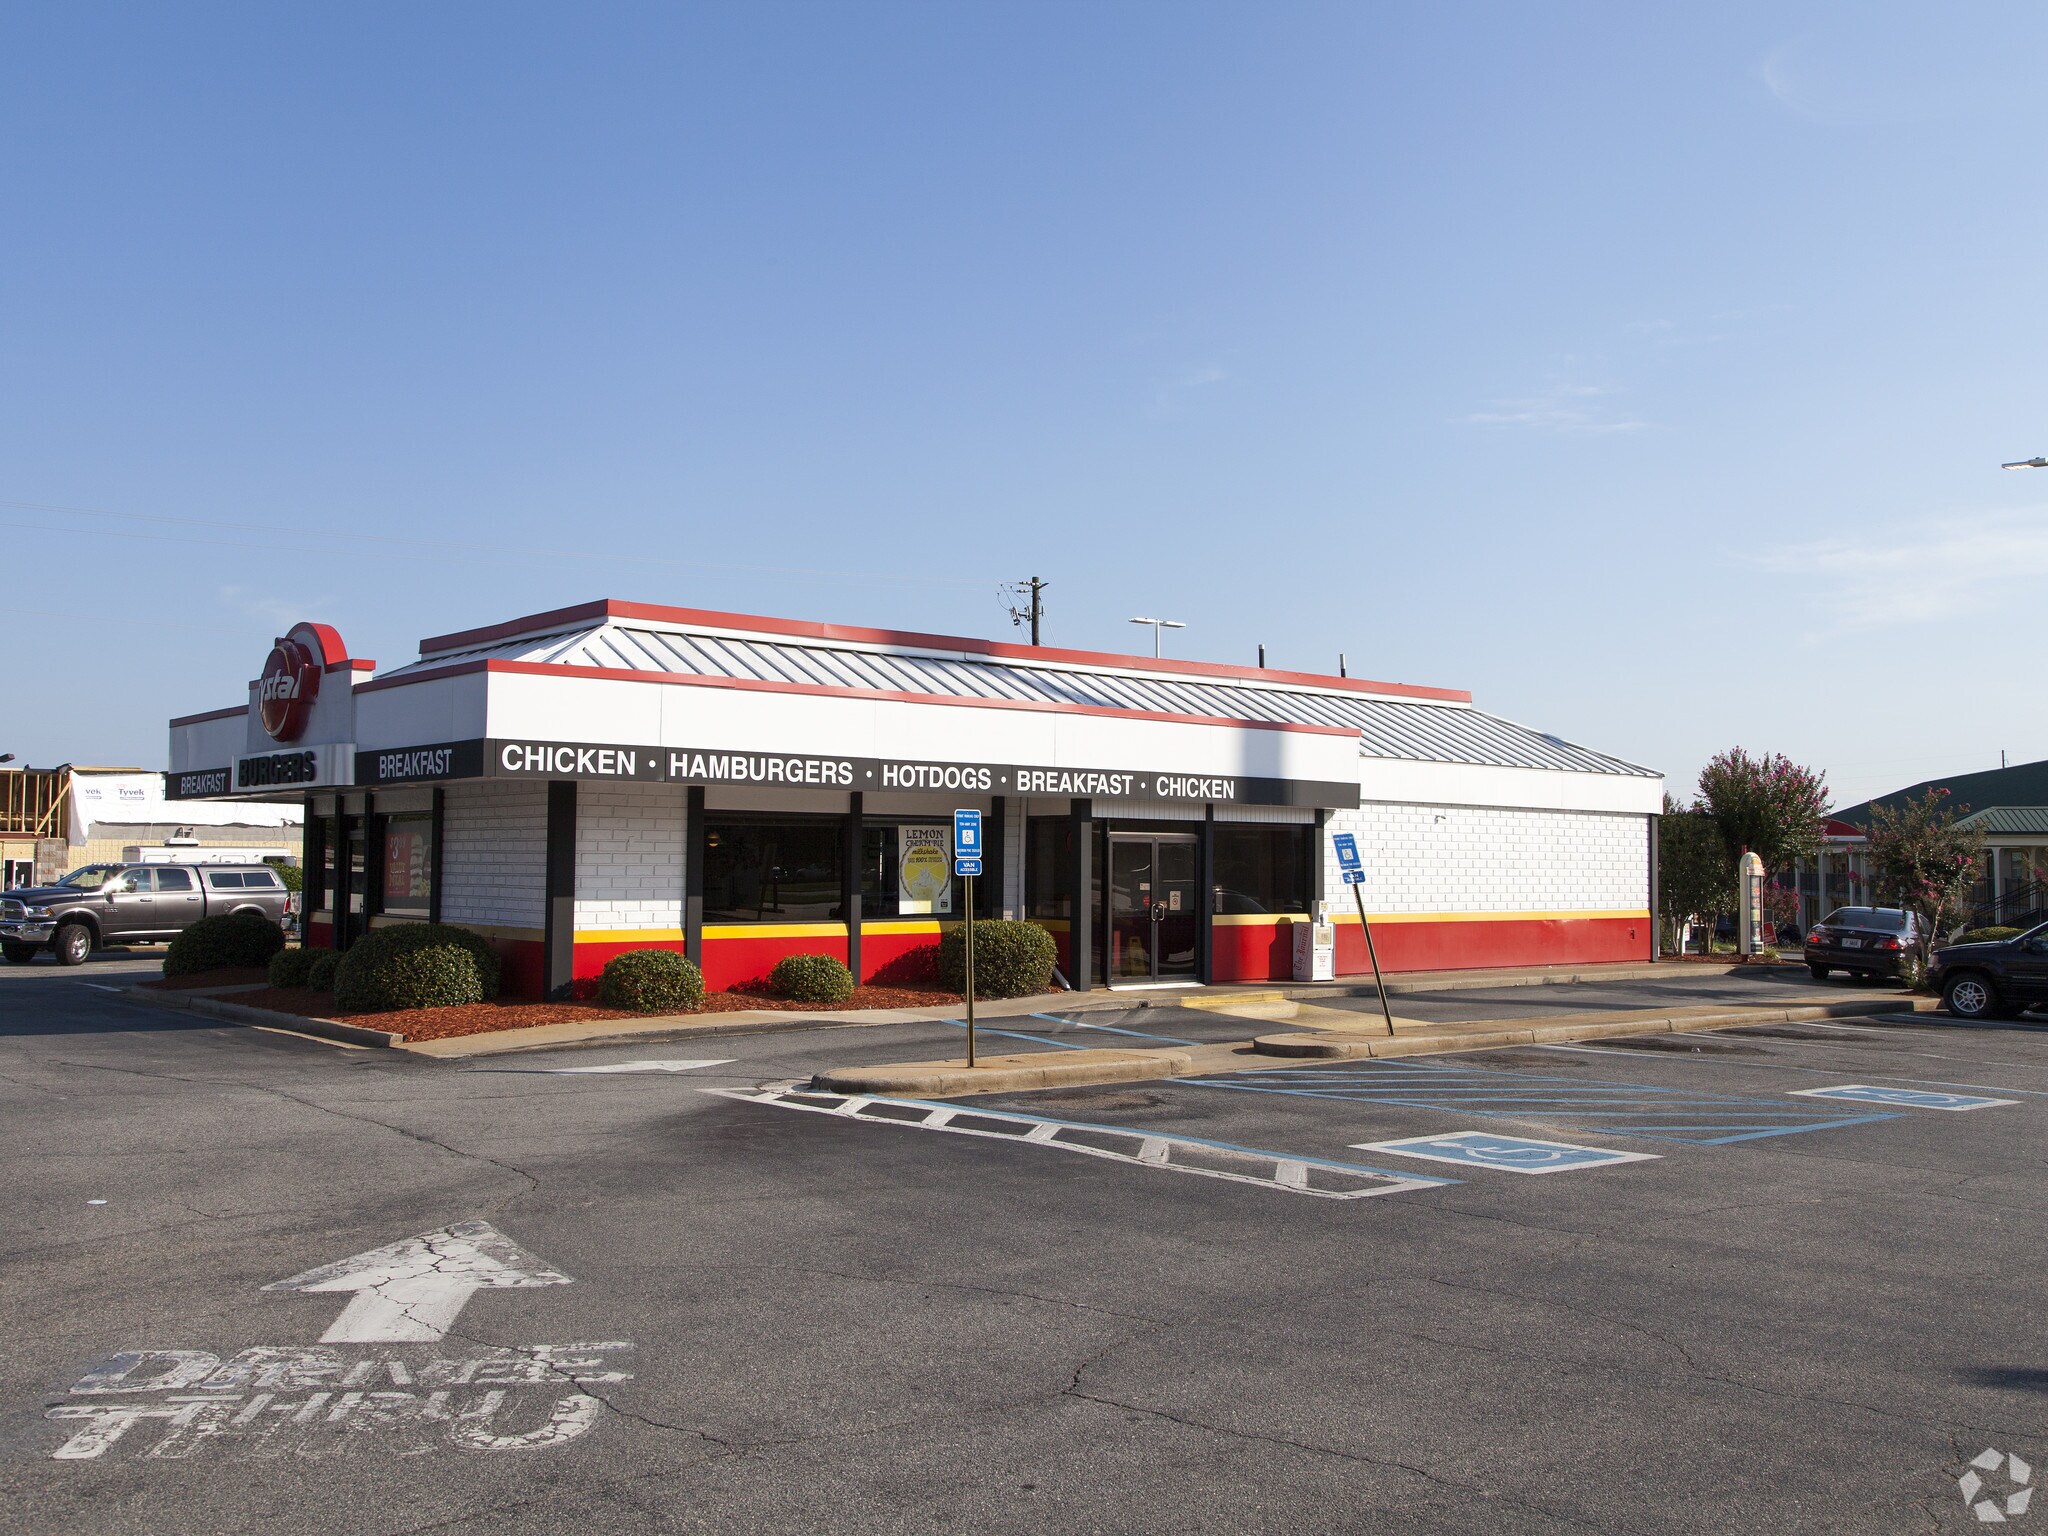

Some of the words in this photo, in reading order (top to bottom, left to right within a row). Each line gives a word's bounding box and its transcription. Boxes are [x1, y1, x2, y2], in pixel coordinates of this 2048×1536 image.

[238, 751, 316, 787] BURGERS
[379, 749, 453, 779] BREAKFAST
[501, 744, 636, 775] CHICKEN
[670, 752, 853, 785] HAMBURGERS
[882, 764, 992, 790] HOTDOGS
[1016, 770, 1134, 795] BREAKFAST
[1156, 776, 1235, 799] CHICKEN
[118, 788, 145, 797] Tyvek
[180, 773, 226, 795] BREAKFAST
[905, 829, 944, 839] LEMON
[1293, 957, 1304, 971] The
